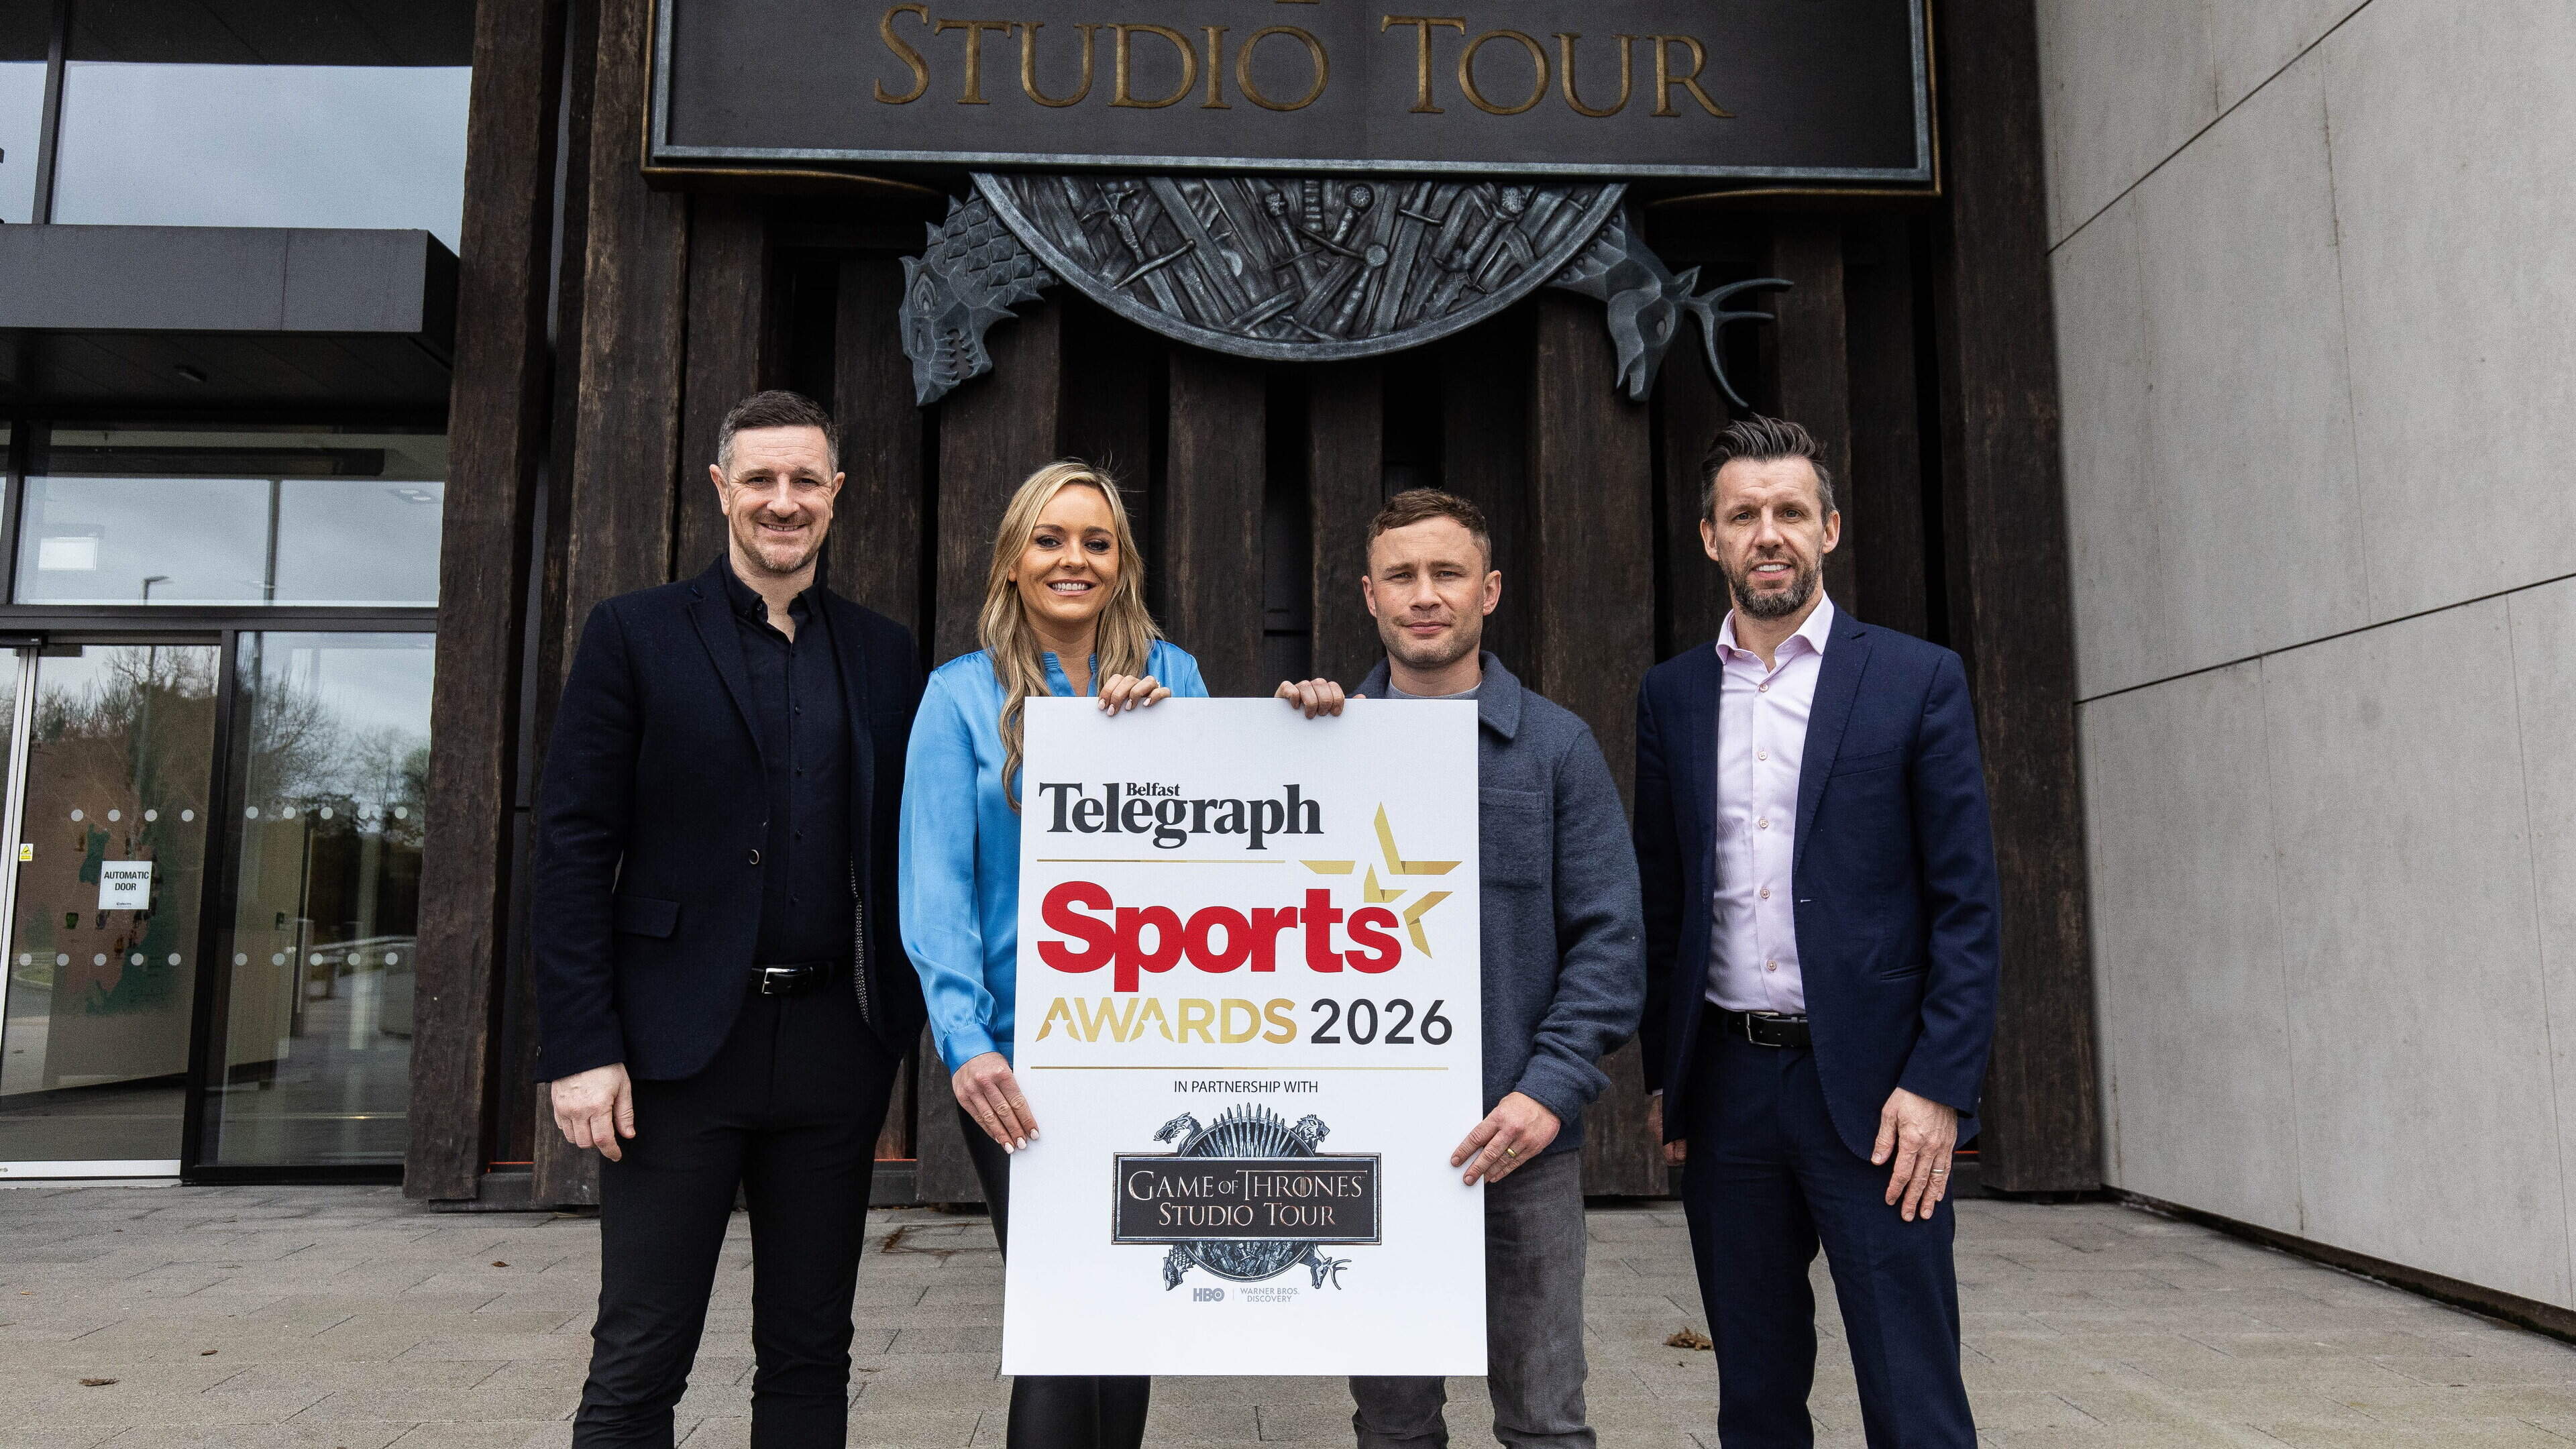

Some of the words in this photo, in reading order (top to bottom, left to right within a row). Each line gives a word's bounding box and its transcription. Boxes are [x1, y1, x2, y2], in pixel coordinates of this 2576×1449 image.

[874, 3, 1330, 111] STUDIO
[1381, 15, 1736, 119] TOUR
[1126, 782, 1181, 797] Belfast
[1038, 782, 1324, 850] Telegraph
[1037, 881, 1402, 993] Sports
[1035, 997, 1298, 1044] AWARDS
[1310, 998, 1453, 1045] 2026
[1174, 1081, 1187, 1093] IN
[1191, 1081, 1281, 1093] PARTNERSHIP
[1284, 1081, 1318, 1093] WITH
[1128, 1171, 1214, 1201] GAME
[1236, 1170, 1368, 1201] THRONES
[1159, 1202, 1254, 1226] STUDIO
[1263, 1202, 1336, 1226] TOUR
[1193, 1287, 1225, 1302] HBO
